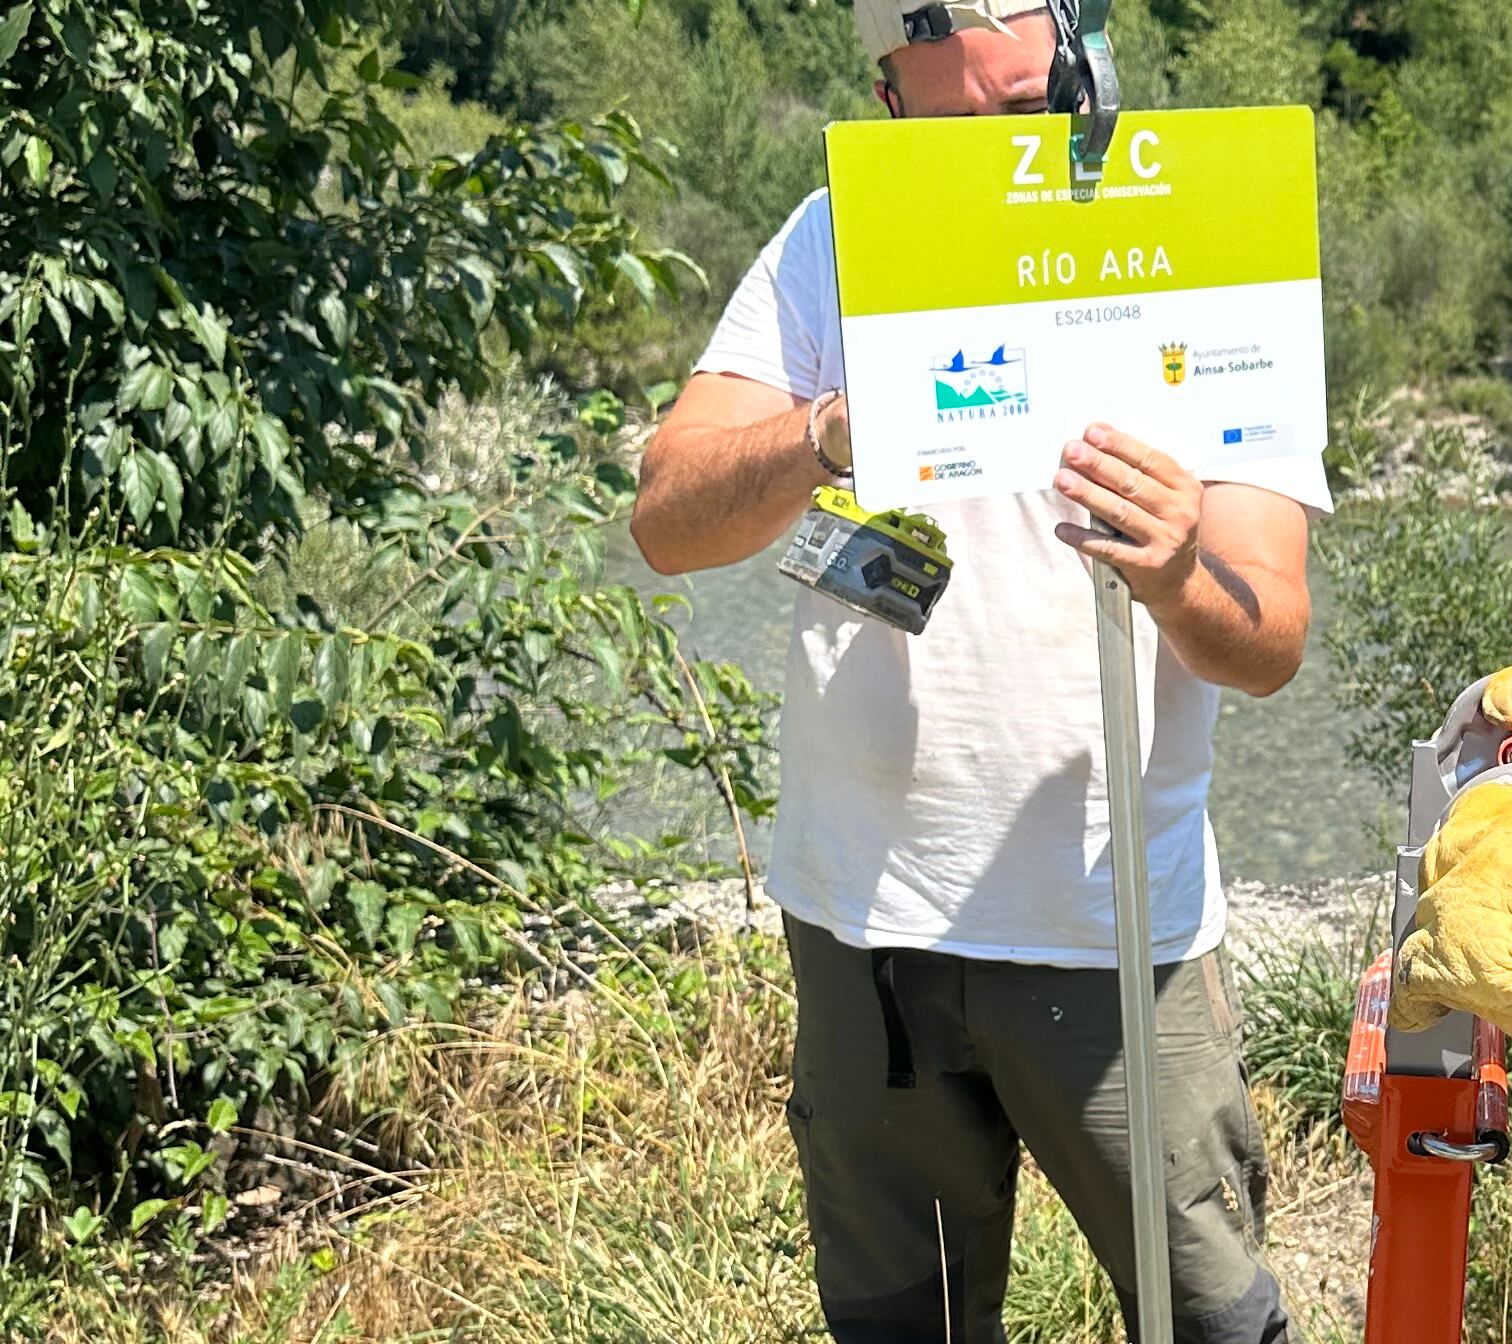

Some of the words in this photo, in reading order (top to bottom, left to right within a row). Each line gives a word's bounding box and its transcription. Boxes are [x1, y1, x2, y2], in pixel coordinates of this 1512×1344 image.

[1006, 190, 1038, 204] ZONAS
[1041, 189, 1053, 202] DE
[1101, 181, 1172, 199] CONSERVACIÓN
[1017, 248, 1076, 288] RÍO
[1099, 245, 1173, 282] ARA
[1055, 305, 1142, 327] ES2410048
[1193, 345, 1250, 360] Ayuntamiento
[1250, 343, 1262, 354] de
[937, 406, 996, 423] NATURA
[1003, 402, 1030, 417] 2000
